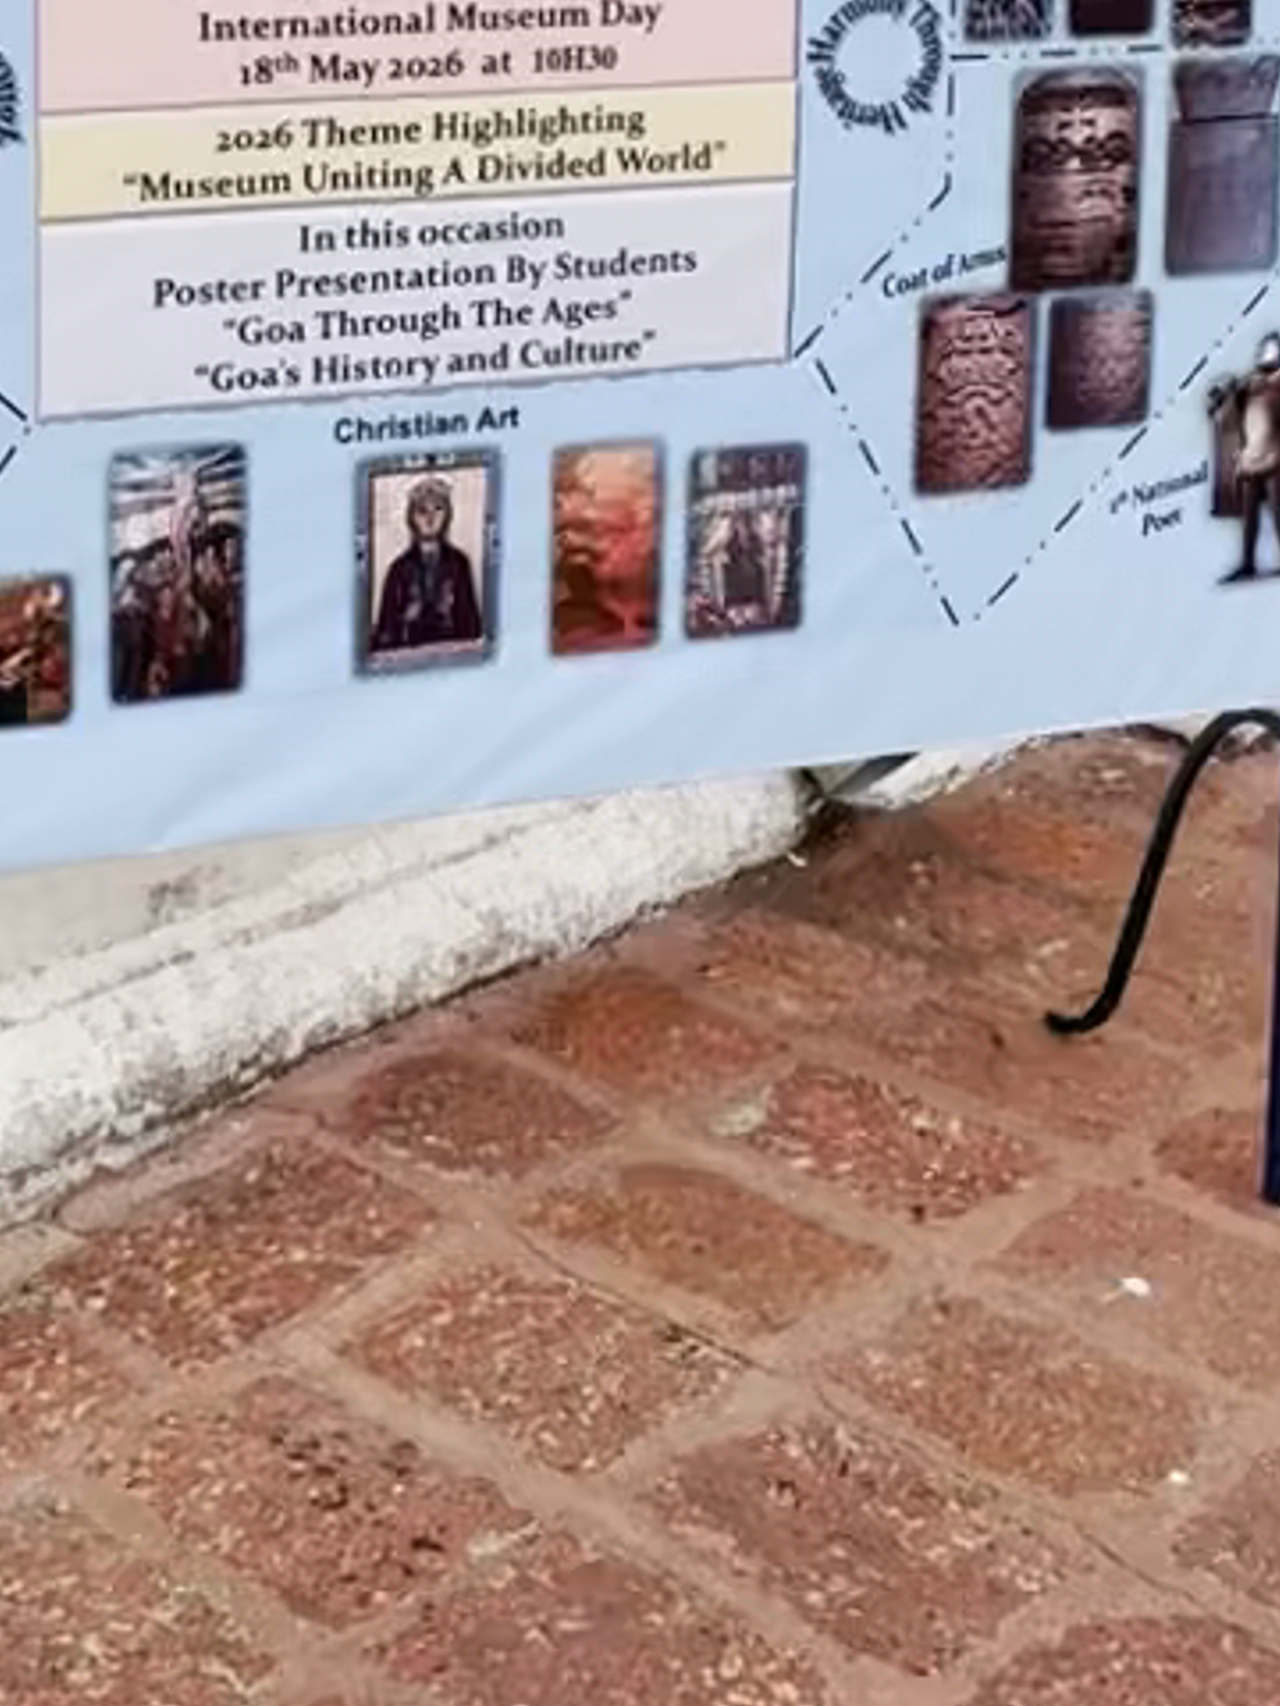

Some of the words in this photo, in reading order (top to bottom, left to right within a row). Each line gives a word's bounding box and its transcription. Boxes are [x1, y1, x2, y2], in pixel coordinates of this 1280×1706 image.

[199, 3, 435, 41] International
[447, 2, 590, 32] Museum
[240, 52, 299, 86] 18th
[309, 54, 380, 87] May
[389, 48, 464, 79] 2026
[481, 51, 512, 74] at
[533, 45, 618, 73] 10H30
[216, 120, 293, 152] 2026
[302, 117, 421, 148] Theme
[433, 105, 645, 145] Highlighting
[304, 160, 434, 195] Uniting
[442, 156, 470, 184] A
[478, 148, 605, 182] Divided
[299, 224, 336, 253] In
[346, 218, 410, 250] this
[418, 211, 564, 246] occasion
[153, 277, 265, 308] Poster
[276, 260, 495, 299] Presentation
[506, 255, 547, 289] By
[553, 248, 697, 280] Students
[315, 301, 461, 341] Through
[470, 299, 533, 329] The
[312, 353, 440, 384] History
[446, 343, 509, 374] and
[333, 410, 469, 443] Christian
[475, 405, 520, 432] Art
